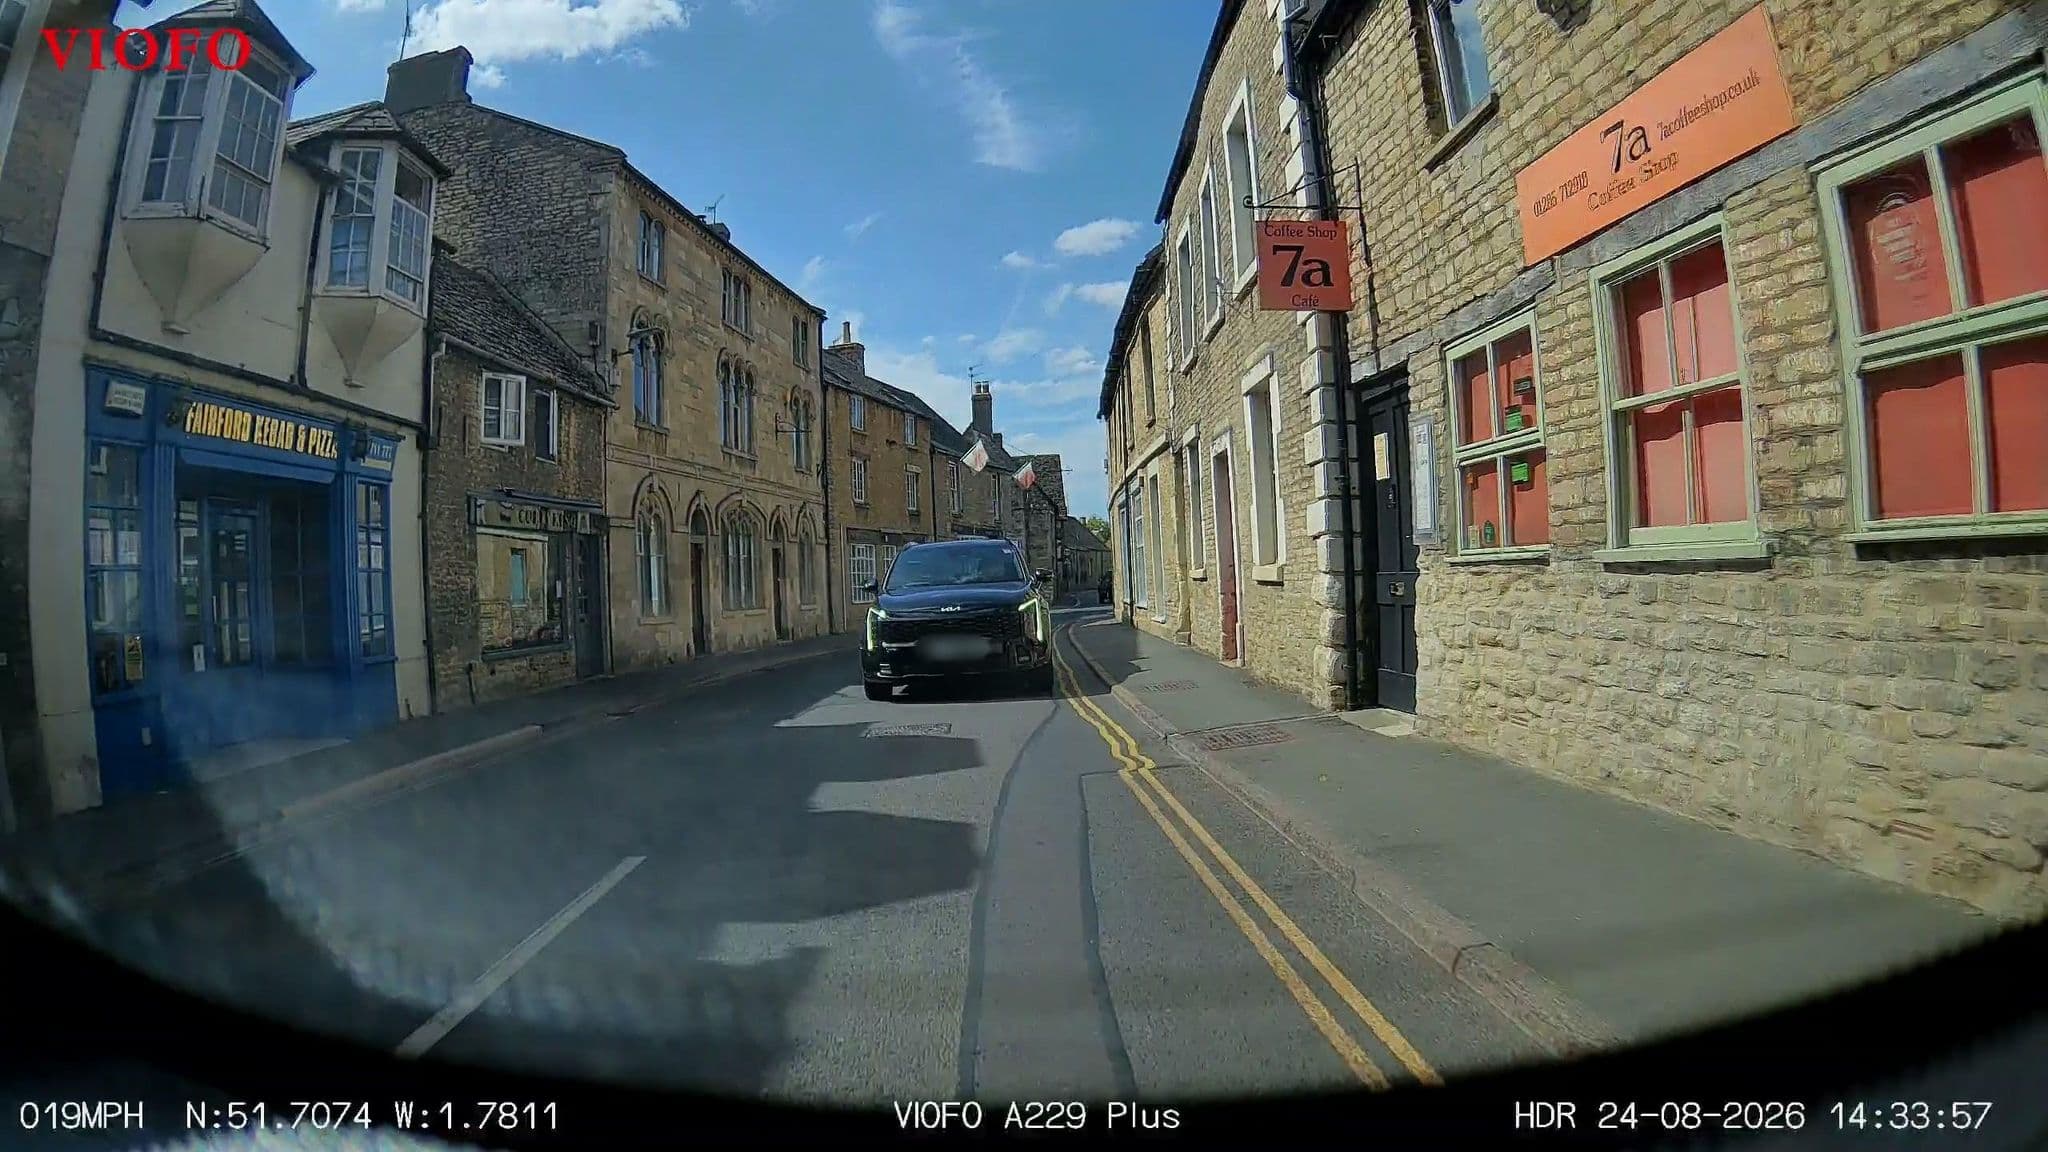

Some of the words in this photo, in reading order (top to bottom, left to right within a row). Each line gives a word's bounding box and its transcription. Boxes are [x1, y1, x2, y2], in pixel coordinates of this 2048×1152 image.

[1600, 119, 1652, 174] 7a
[1264, 224, 1304, 238] Coffee
[1307, 225, 1338, 241] Shop
[1272, 244, 1335, 288] 7a
[1291, 294, 1320, 307] Café
[184, 401, 252, 443] FAIRFORD
[253, 414, 296, 450] KEBAB
[296, 424, 307, 453] &
